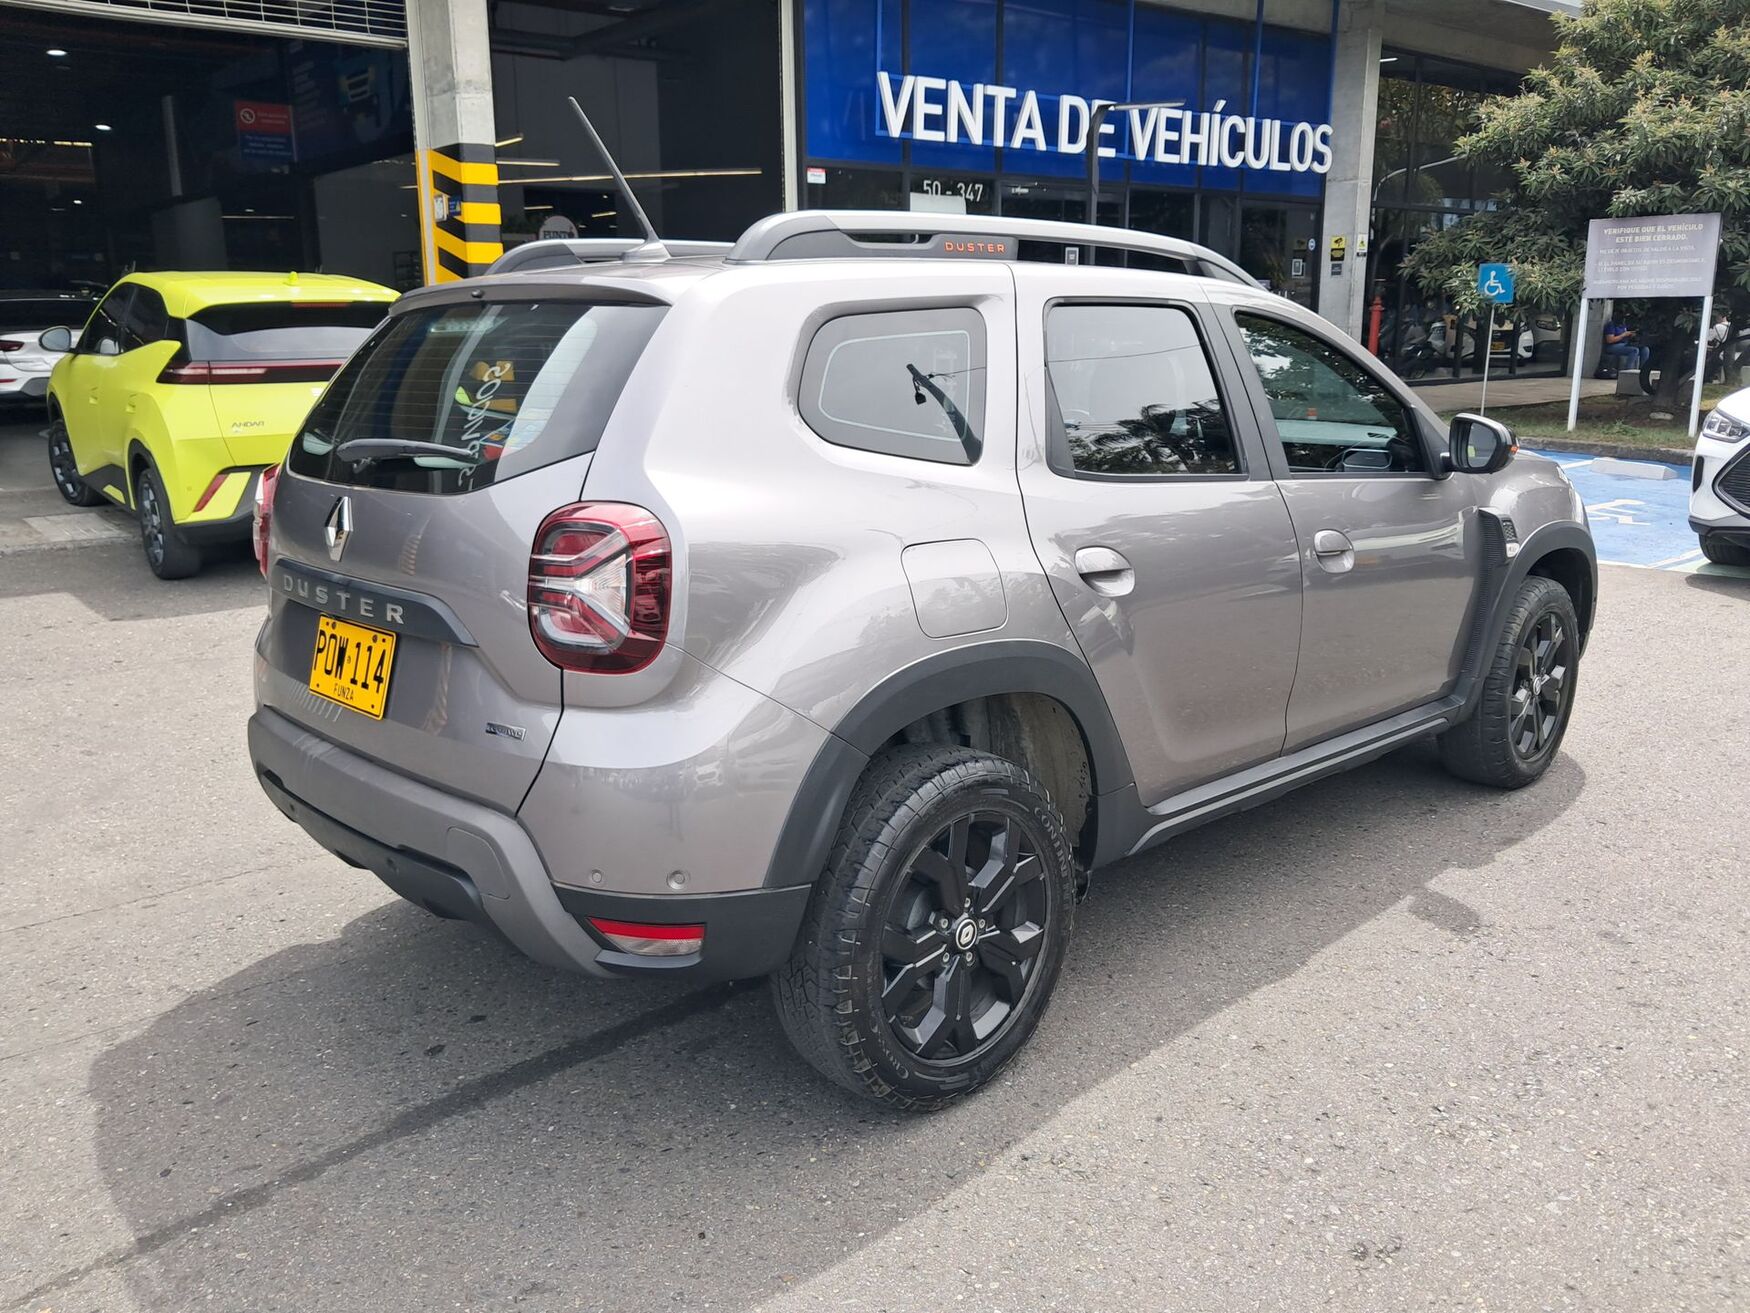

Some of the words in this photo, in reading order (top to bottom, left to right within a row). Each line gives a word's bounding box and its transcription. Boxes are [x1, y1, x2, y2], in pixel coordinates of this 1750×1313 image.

[877, 71, 1047, 151] VENTA
[1058, 94, 1117, 158] DE
[1130, 100, 1334, 174] VEHÍCULOS
[957, 183, 983, 202] 347
[1657, 225, 1666, 233] EL
[944, 242, 1006, 253] DUSTER
[283, 574, 405, 625] DUSTER
[350, 642, 385, 693] 114
[333, 682, 354, 701] FUNZA
